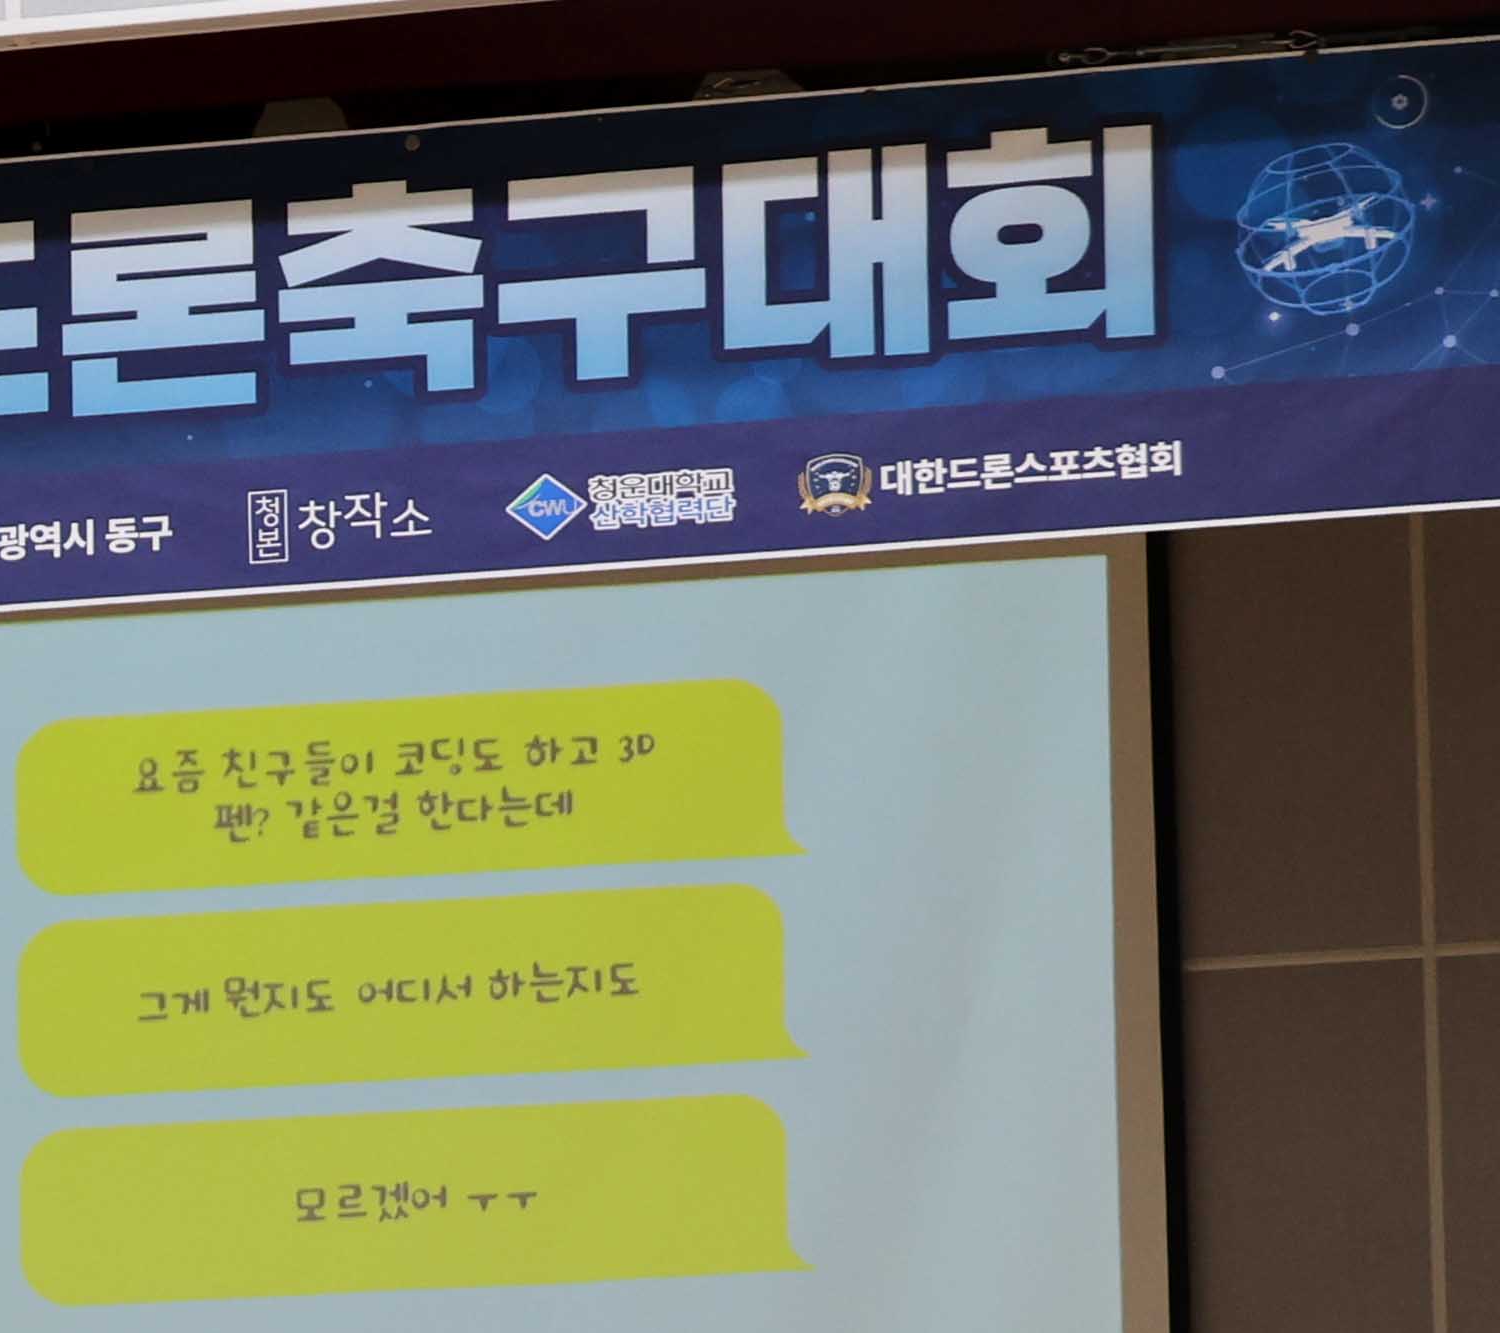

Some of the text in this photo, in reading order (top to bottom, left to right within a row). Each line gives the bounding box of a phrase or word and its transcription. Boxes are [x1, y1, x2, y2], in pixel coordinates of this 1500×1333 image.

[590, 469, 734, 501] 청운대학교
[880, 440, 1183, 496] 대한드론스포츠협회
[104, 515, 173, 554] 동구
[298, 491, 433, 550] 창작소
[527, 502, 580, 518] CWU
[593, 499, 736, 529] 산학협력단
[132, 733, 656, 795] 요즘 친구들이 코딩도 하고 3D
[214, 803, 271, 844] 펜?
[416, 785, 573, 832] 한다는데
[138, 961, 640, 1022] 그게 뭔지도 어디서 하는지도
[296, 1180, 448, 1223] 모르겠어
